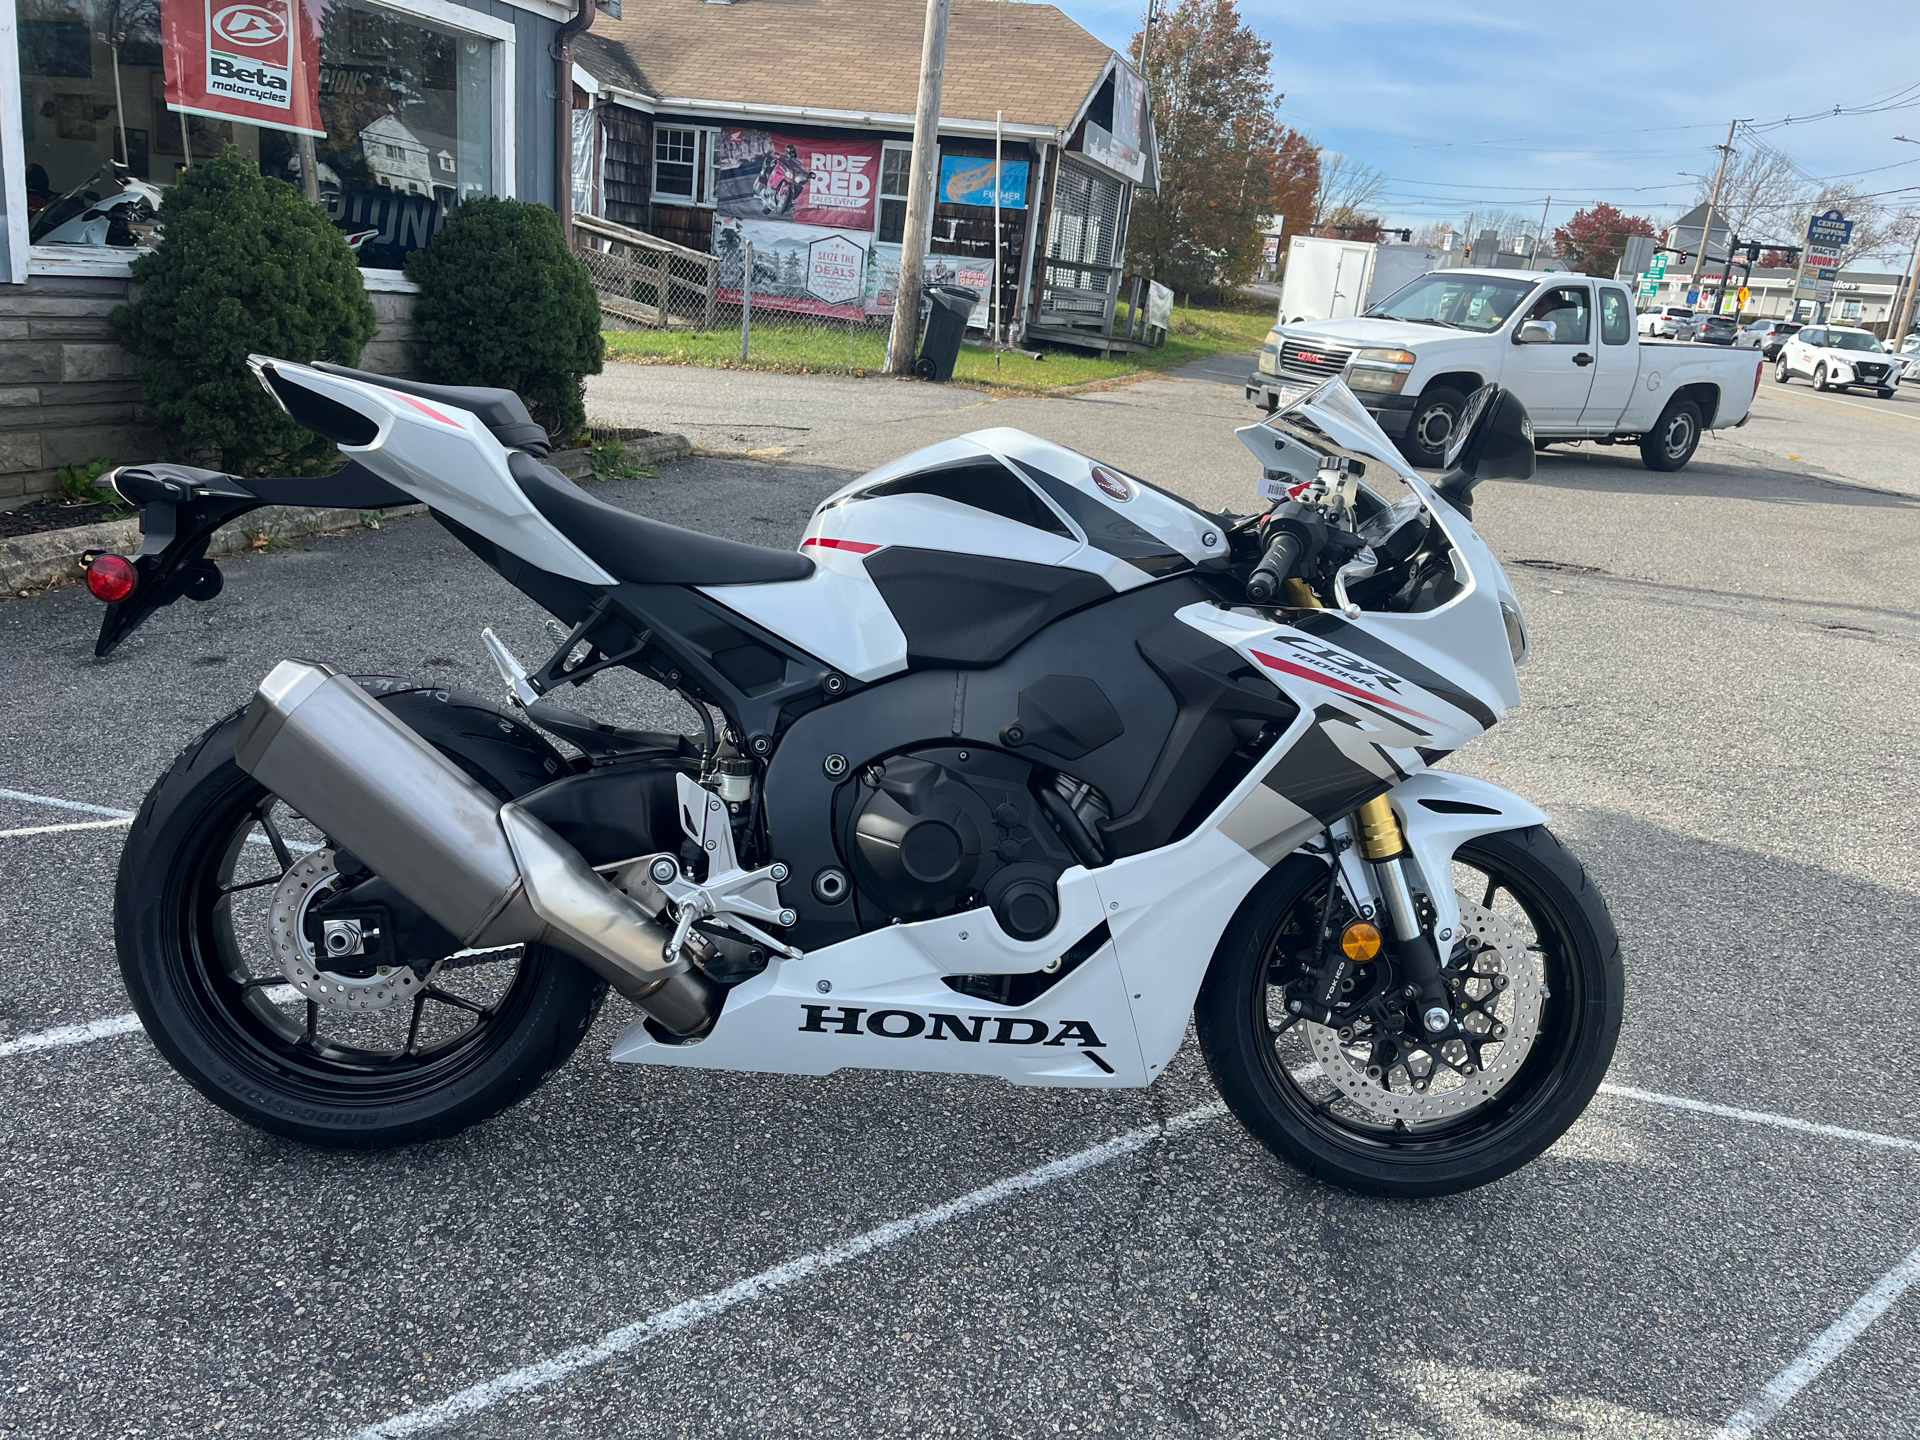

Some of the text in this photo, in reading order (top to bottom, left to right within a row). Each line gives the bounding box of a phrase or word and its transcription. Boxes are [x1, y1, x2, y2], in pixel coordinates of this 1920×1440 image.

[211, 57, 287, 91] Beta
[212, 81, 287, 103] motorcycles
[811, 153, 872, 173] RIDE
[810, 170, 870, 197] RED
[812, 195, 858, 206] SALES EVENT
[983, 190, 1020, 200] FUMER
[1817, 220, 1846, 229] CENTER
[1812, 226, 1847, 237] SHOPPING
[1814, 234, 1842, 242] PLAZA
[818, 251, 855, 264] SEIZE THE
[815, 265, 855, 278] DEALS
[958, 269, 986, 280] dream
[960, 277, 989, 287] garage
[1297, 351, 1326, 364] GMC
[1272, 635, 1403, 696] CBR
[1291, 653, 1376, 690] 1000RR
[1326, 962, 1345, 1001] TOKICO
[798, 1004, 1107, 1047] HONDA
[217, 1071, 380, 1125] BRIDGESTONE
